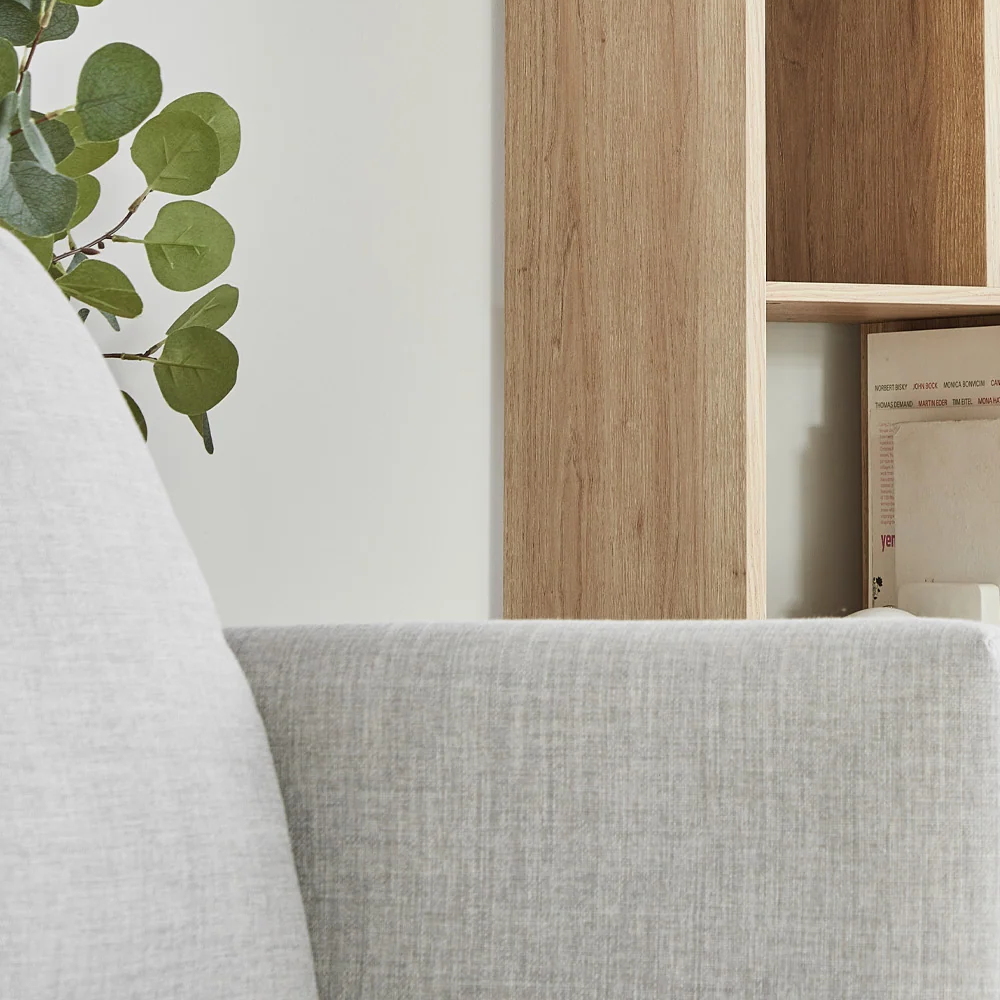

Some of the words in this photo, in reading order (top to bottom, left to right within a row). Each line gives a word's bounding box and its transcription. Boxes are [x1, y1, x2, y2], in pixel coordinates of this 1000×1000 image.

[895, 383, 908, 391] BISKY
[913, 382, 925, 390] JOHN
[875, 401, 893, 409] THOMAS
[952, 398, 960, 406] TIM
[977, 397, 992, 405] MONA
